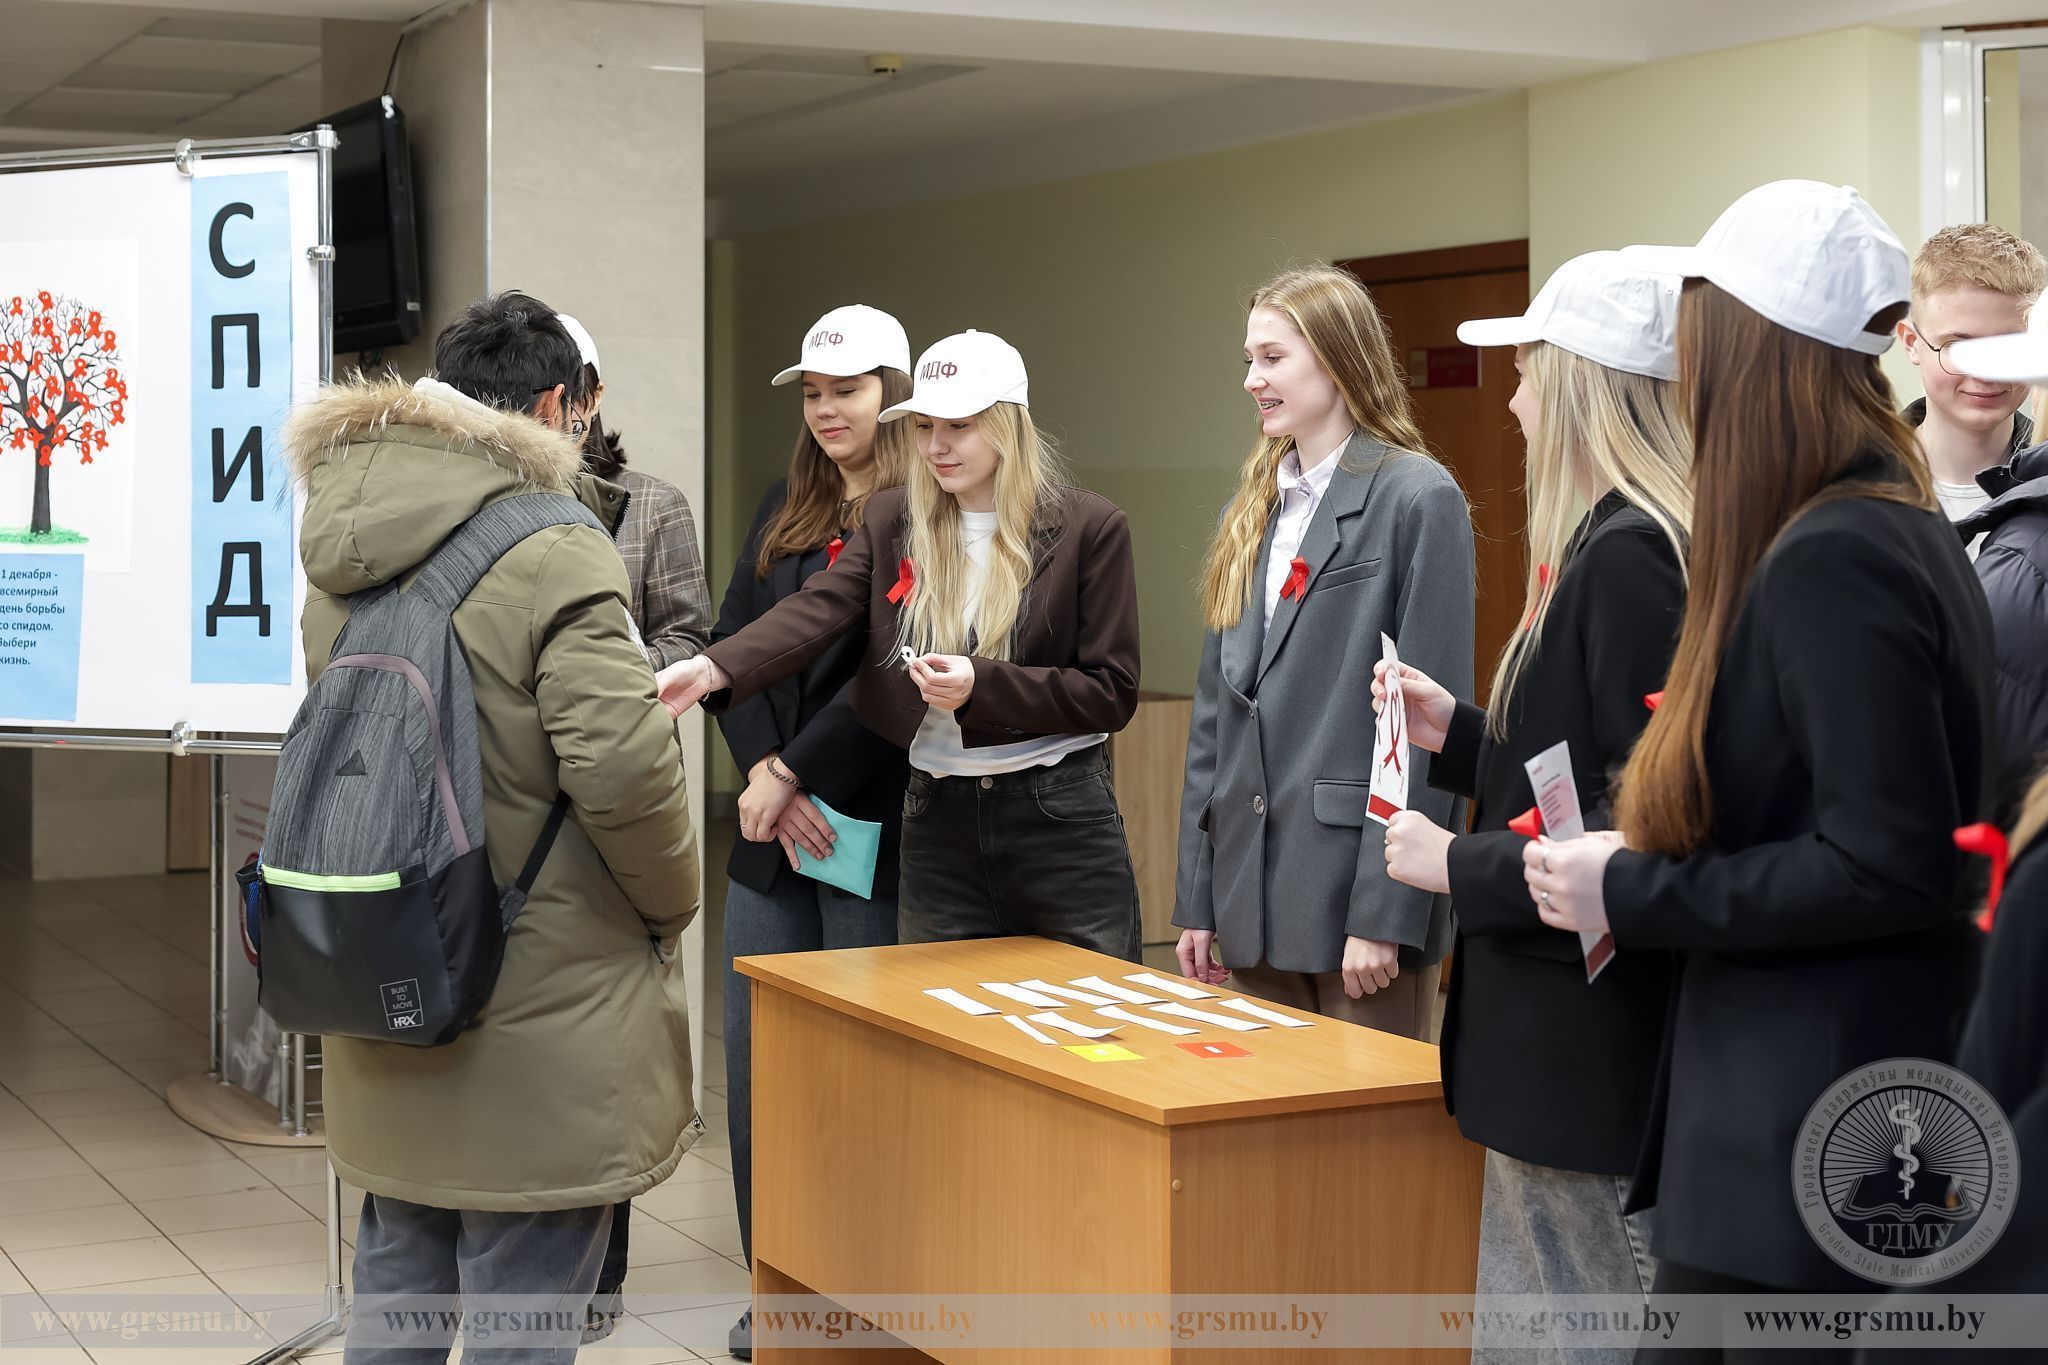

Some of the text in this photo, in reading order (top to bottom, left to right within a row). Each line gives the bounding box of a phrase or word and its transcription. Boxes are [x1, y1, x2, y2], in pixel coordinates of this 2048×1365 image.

[808, 330, 844, 350] МДФ
[919, 360, 958, 382] МДФ
[206, 201, 272, 638] СПИД
[1, 569, 6, 579] 1
[9, 568, 52, 581] декабря
[25, 602, 65, 615] борьбы
[11, 622, 54, 632] спидом.
[391, 985, 408, 994] BUILT
[392, 1000, 413, 1010] MOVE
[393, 1011, 417, 1027] HRX
